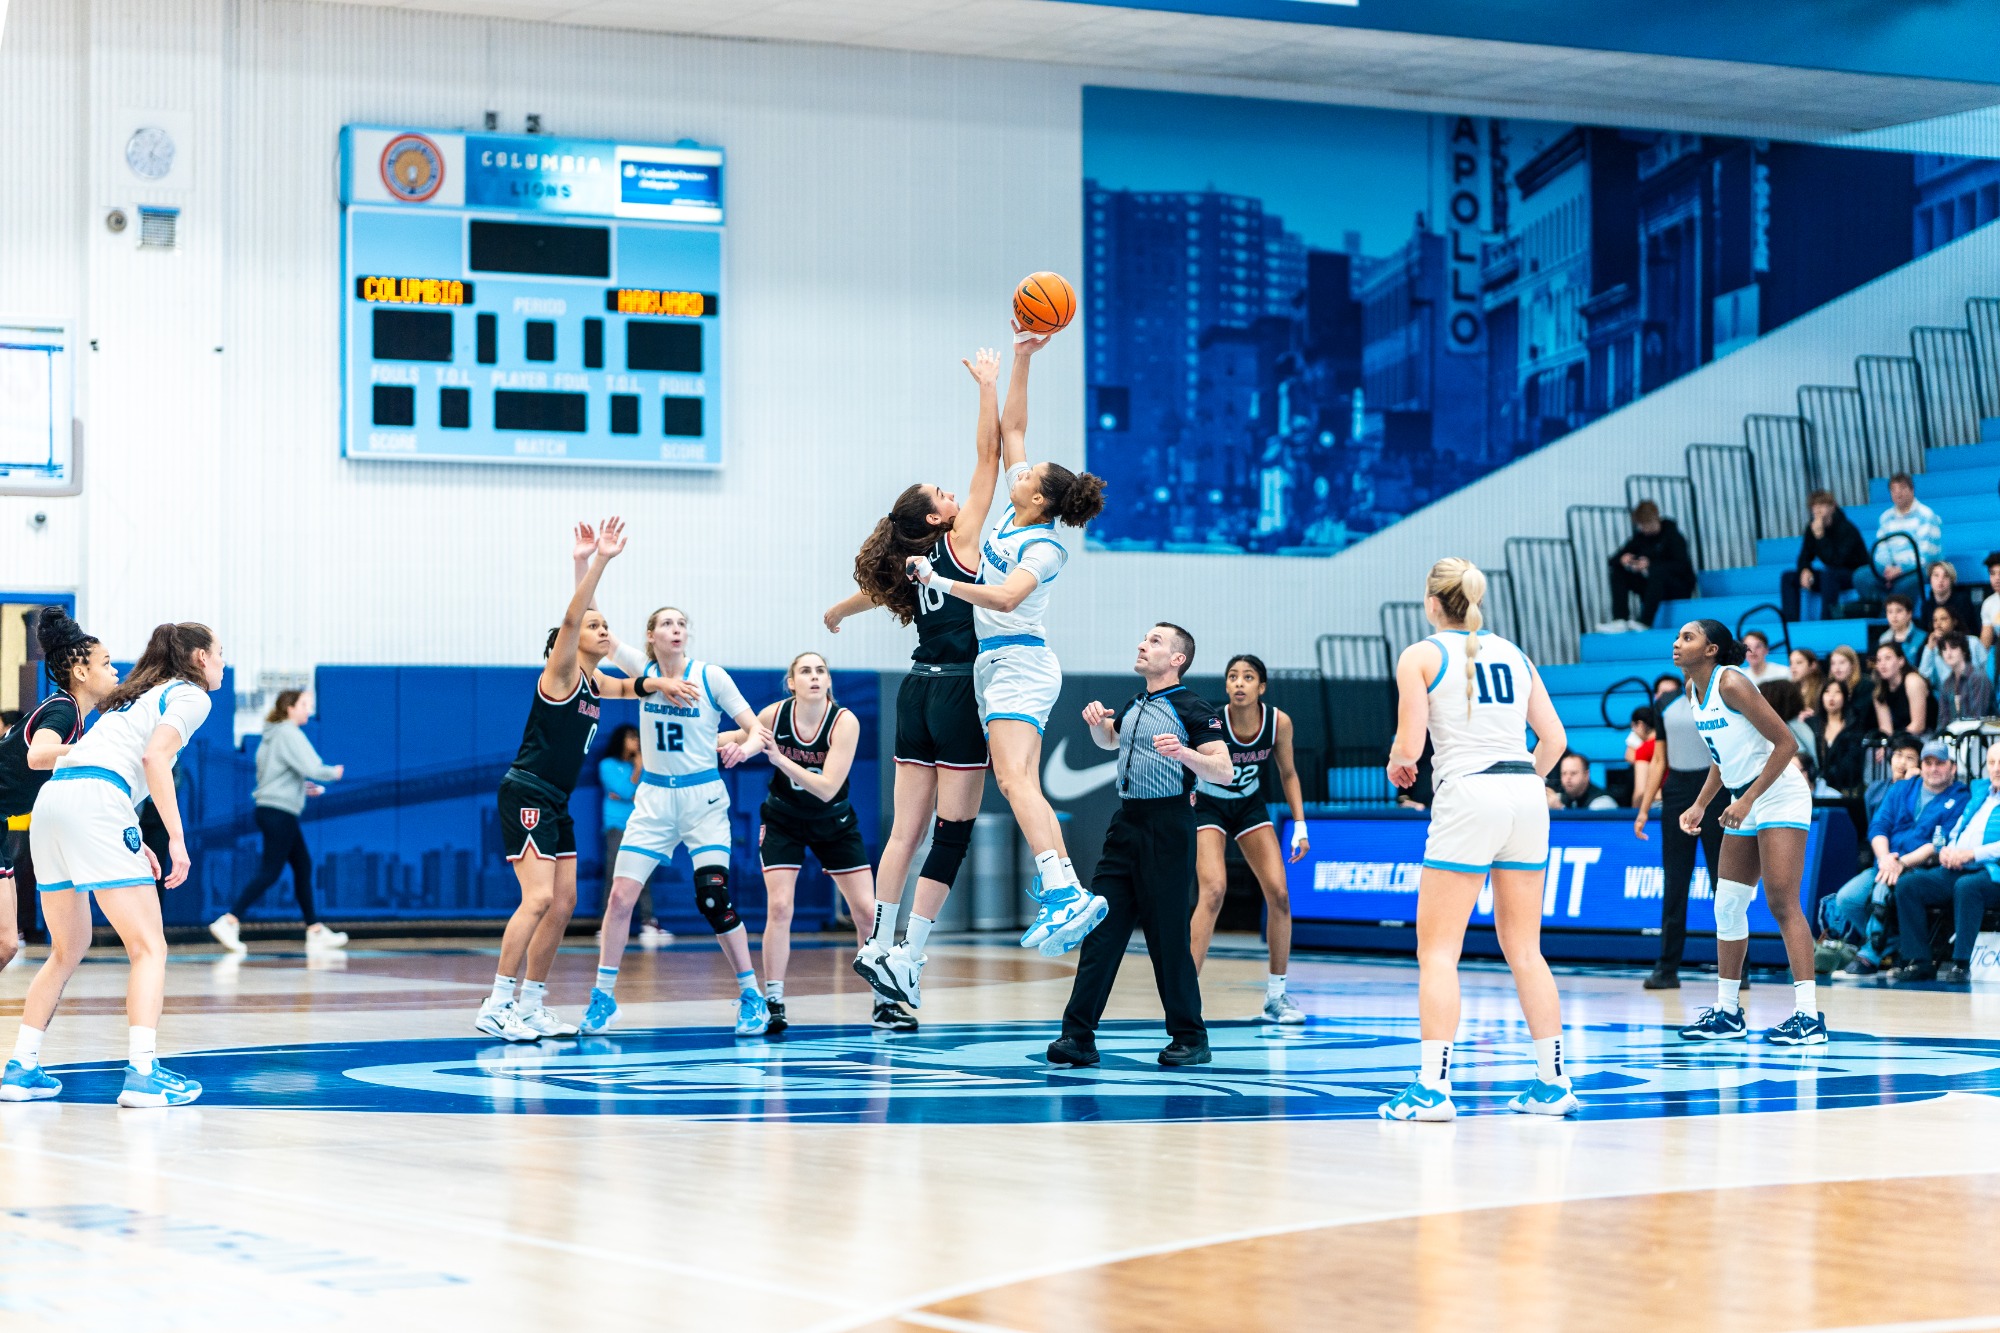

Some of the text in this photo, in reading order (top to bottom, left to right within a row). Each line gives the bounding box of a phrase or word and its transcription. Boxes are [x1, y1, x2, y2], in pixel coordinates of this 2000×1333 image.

[481, 150, 601, 173] COLUMBIA
[510, 181, 571, 199] LIONS
[1452, 115, 1479, 345] APOLLO
[364, 276, 463, 305] COLUMBIA
[912, 580, 945, 616] 10
[1474, 662, 1515, 704] 10
[655, 721, 684, 752] 12
[525, 810, 536, 825] H
